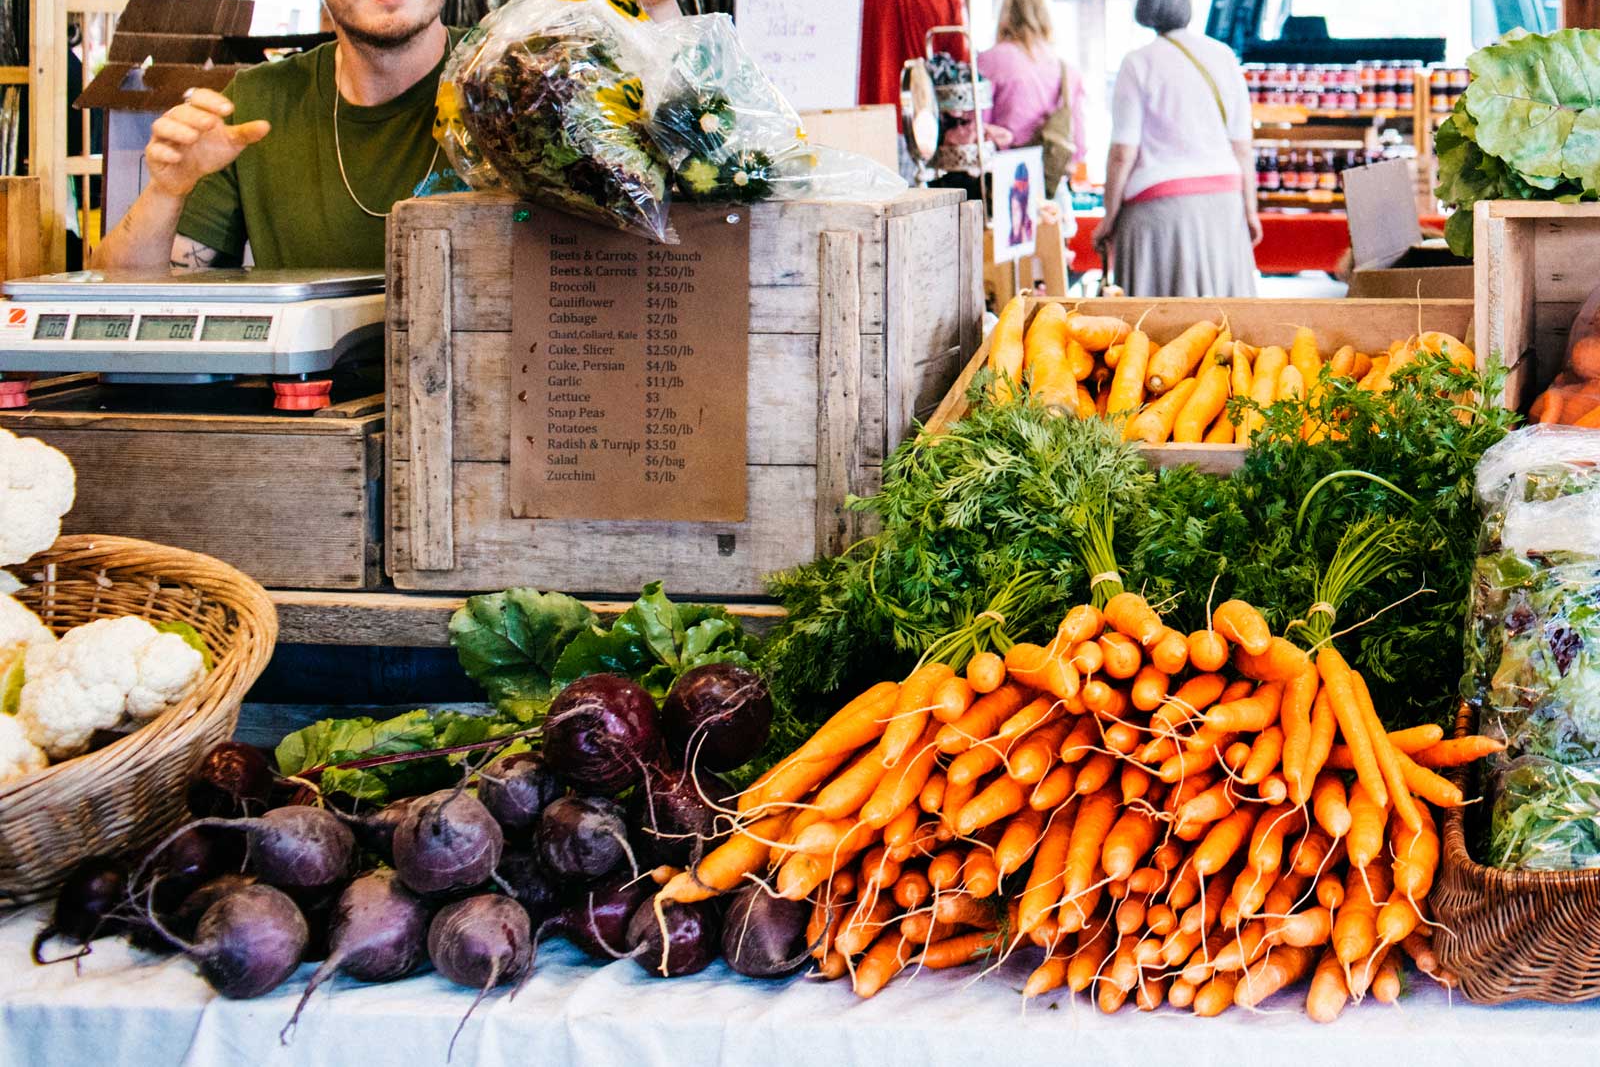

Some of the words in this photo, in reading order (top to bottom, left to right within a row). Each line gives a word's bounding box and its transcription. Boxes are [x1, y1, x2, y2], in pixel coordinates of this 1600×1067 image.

[550, 234, 577, 245] Basil
[550, 250, 580, 261] Beets
[583, 250, 592, 261] &
[596, 250, 638, 262] Carrots
[647, 250, 702, 263] $4/bunch
[550, 266, 580, 277] Beets
[583, 266, 593, 277] &
[595, 266, 637, 277] Carrots
[647, 266, 695, 279] $2.50/lb
[549, 281, 596, 293] Broccoli
[646, 282, 695, 295] $4.50/lb
[549, 297, 614, 308] Cauliflower
[646, 298, 678, 310] $4/lb
[549, 312, 598, 326] Cabbage
[646, 313, 678, 326] $2/lb
[617, 330, 638, 340] Kale
[646, 329, 677, 340] $3.50
[548, 344, 581, 356] Cuke,
[583, 344, 614, 356] Slicer
[646, 345, 694, 358] $2.50/lb
[548, 360, 580, 372] Cuke,
[583, 360, 625, 371] Persian
[646, 361, 677, 373] $4/lb
[548, 376, 582, 387] Garlic
[646, 377, 684, 390] $11/lb
[548, 391, 591, 402] Lettuce
[646, 392, 660, 403] $3
[547, 407, 576, 420] Snap
[579, 407, 605, 418] Peas
[645, 408, 677, 421] $7/lb
[548, 423, 598, 434] Potatoes
[645, 423, 693, 436] $2.50/lb
[547, 438, 586, 449] Radish
[589, 439, 598, 449] &
[602, 439, 640, 453] Turnip
[645, 439, 676, 451] $3.50
[546, 454, 578, 465] Salad
[645, 455, 685, 469] $6/bag
[546, 470, 596, 481] Zucchini
[645, 471, 676, 484] $3/lb
